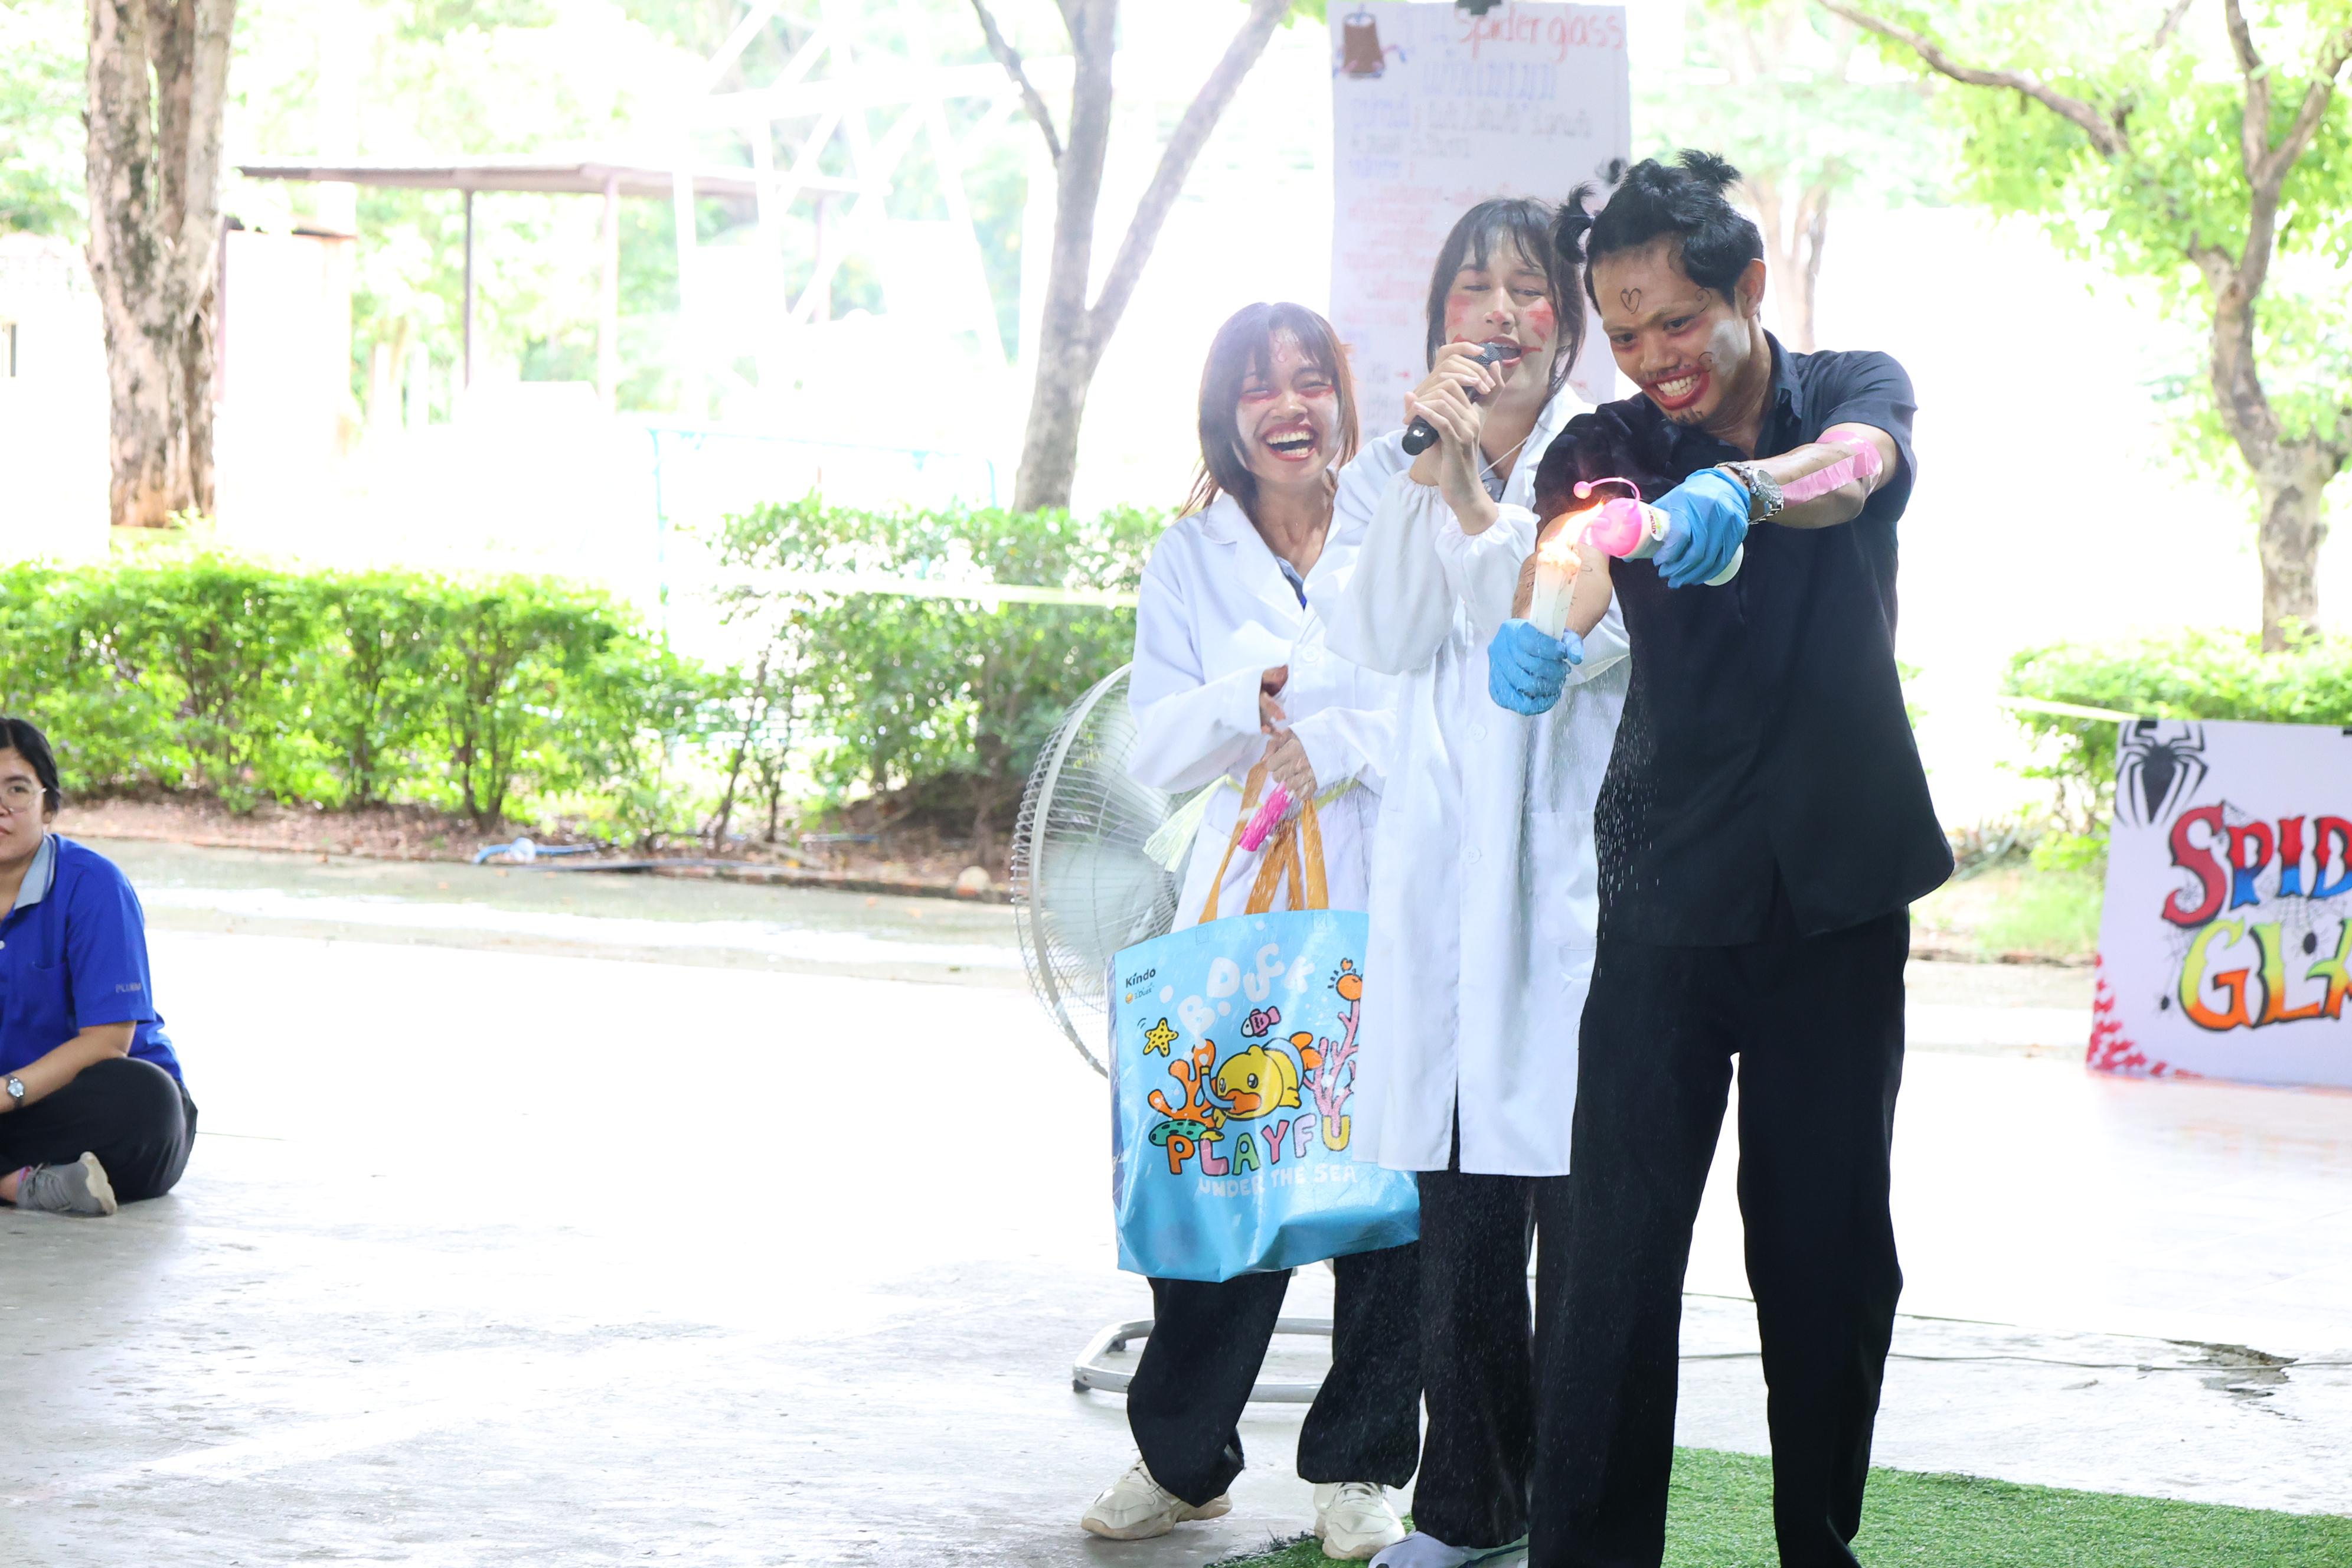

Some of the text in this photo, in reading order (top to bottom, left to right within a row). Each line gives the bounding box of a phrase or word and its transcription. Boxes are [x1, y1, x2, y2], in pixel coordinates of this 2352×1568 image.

[1547, 3, 1624, 63] glass
[2162, 800, 2352, 929] SPID
[1125, 968, 1156, 988] Kindo
[1198, 1162, 1358, 1197] UNDER THE SEA
